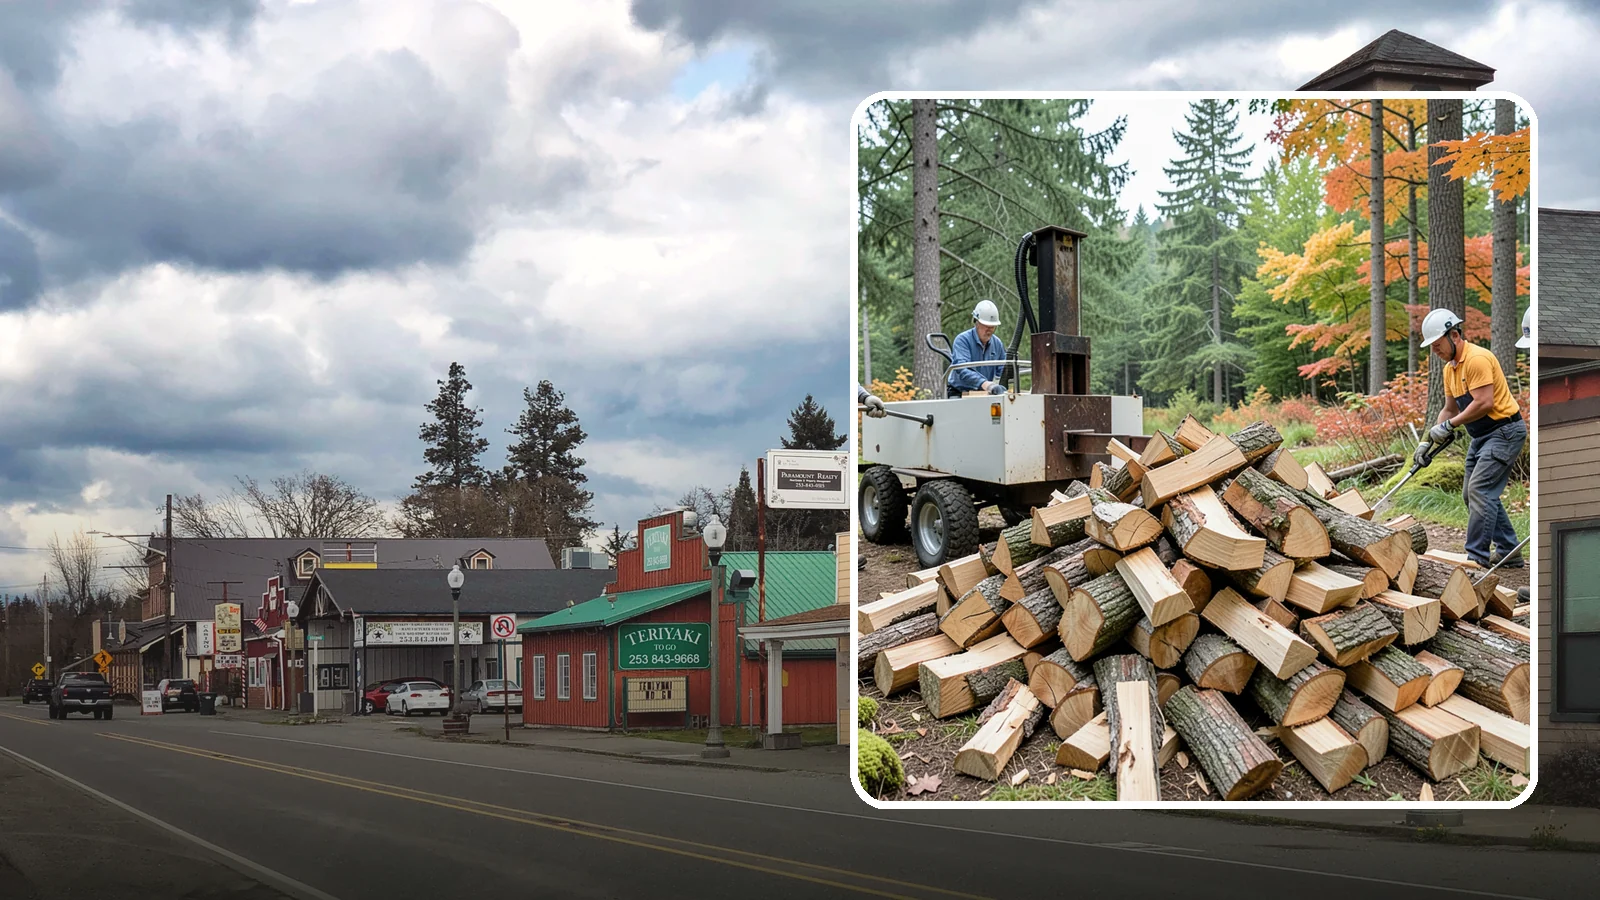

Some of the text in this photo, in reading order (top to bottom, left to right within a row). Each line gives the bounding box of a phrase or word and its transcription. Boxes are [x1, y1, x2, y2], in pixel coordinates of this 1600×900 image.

[817, 472, 839, 480] REALTY
[625, 627, 702, 646] TERIYAKI
[629, 653, 700, 665] 253 843-9668
